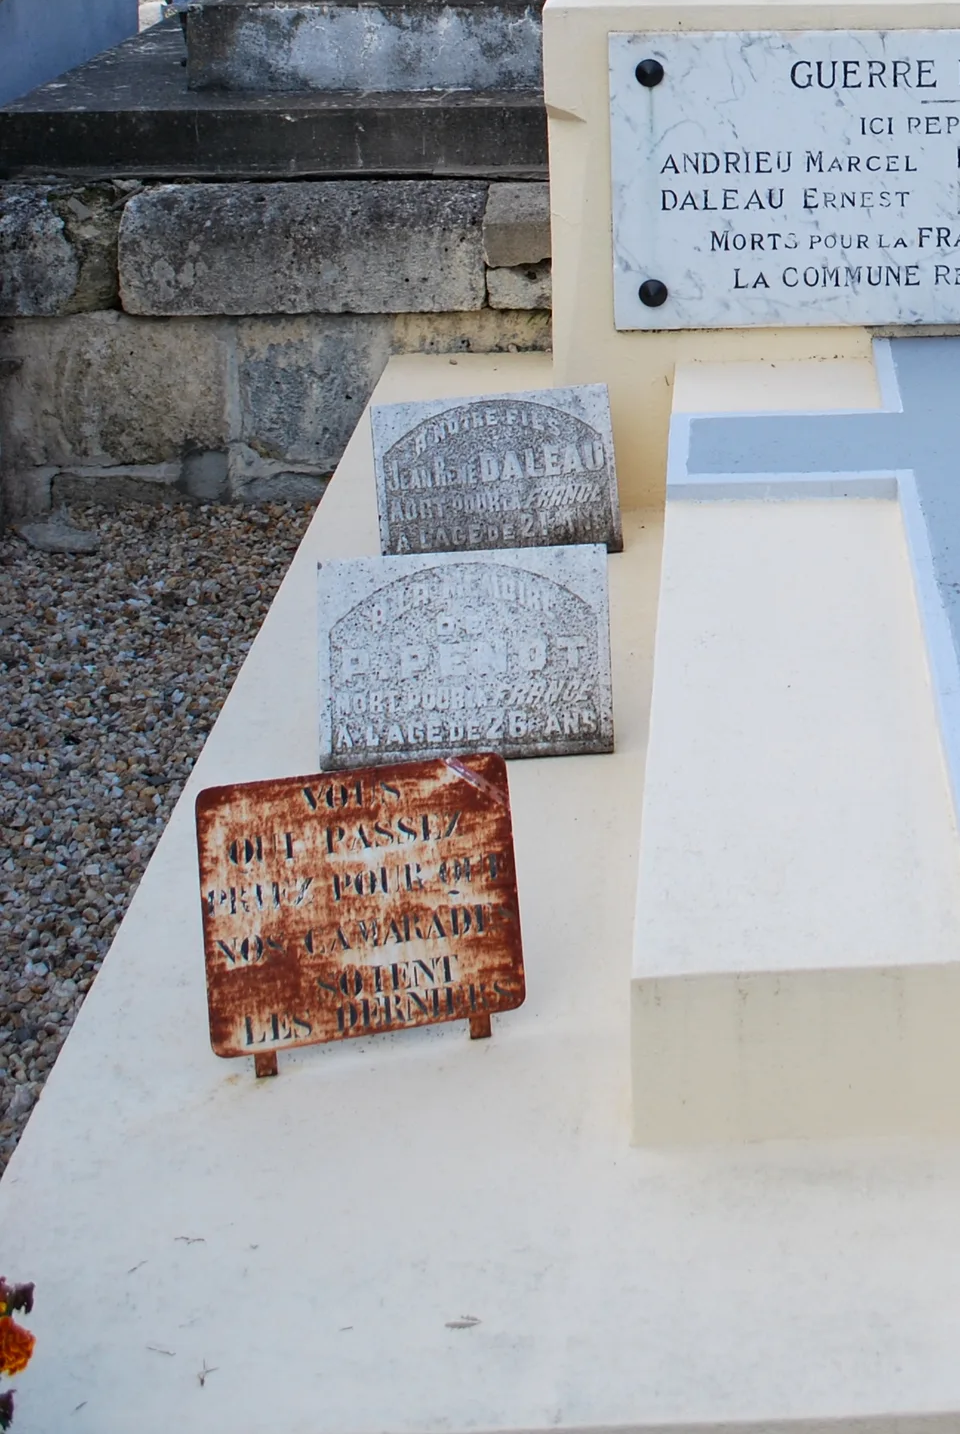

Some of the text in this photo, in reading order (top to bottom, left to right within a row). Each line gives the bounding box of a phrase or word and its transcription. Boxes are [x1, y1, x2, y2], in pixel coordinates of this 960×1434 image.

[790, 59, 937, 89] GUERRE
[859, 116, 894, 136] ICI
[660, 149, 918, 175] ANDRIEU MARCEL
[661, 187, 911, 212] DALEAU ERNEST
[709, 229, 799, 251] MORTS
[808, 233, 870, 250] POUR
[877, 233, 909, 249] LA
[733, 267, 770, 290] LA
[781, 264, 921, 288] COMMUNE
[433, 411, 498, 443] NOTRE
[506, 408, 562, 437] FILS
[388, 459, 433, 491] JEAN
[480, 439, 607, 484] DALEAU
[390, 495, 445, 523] MORT
[453, 490, 501, 515] POUR
[523, 481, 602, 509] FRANCE
[489, 522, 516, 542] DE
[400, 635, 589, 678] PENOT
[335, 690, 402, 715] MORT
[407, 685, 465, 712] POUR
[493, 678, 594, 707] FRANCE
[336, 724, 353, 749] A
[449, 719, 481, 742] DE
[486, 710, 527, 740] 26
[544, 710, 597, 736] ANS
[303, 780, 400, 812] VOUS
[229, 810, 462, 873] QUI PASSEZ
[207, 876, 314, 916] PRIEZ
[332, 861, 423, 902] POUR
[216, 901, 517, 964] NOS CAMARADES
[316, 952, 459, 998] SOIENT
[244, 979, 516, 1046] LES DERNIERS
